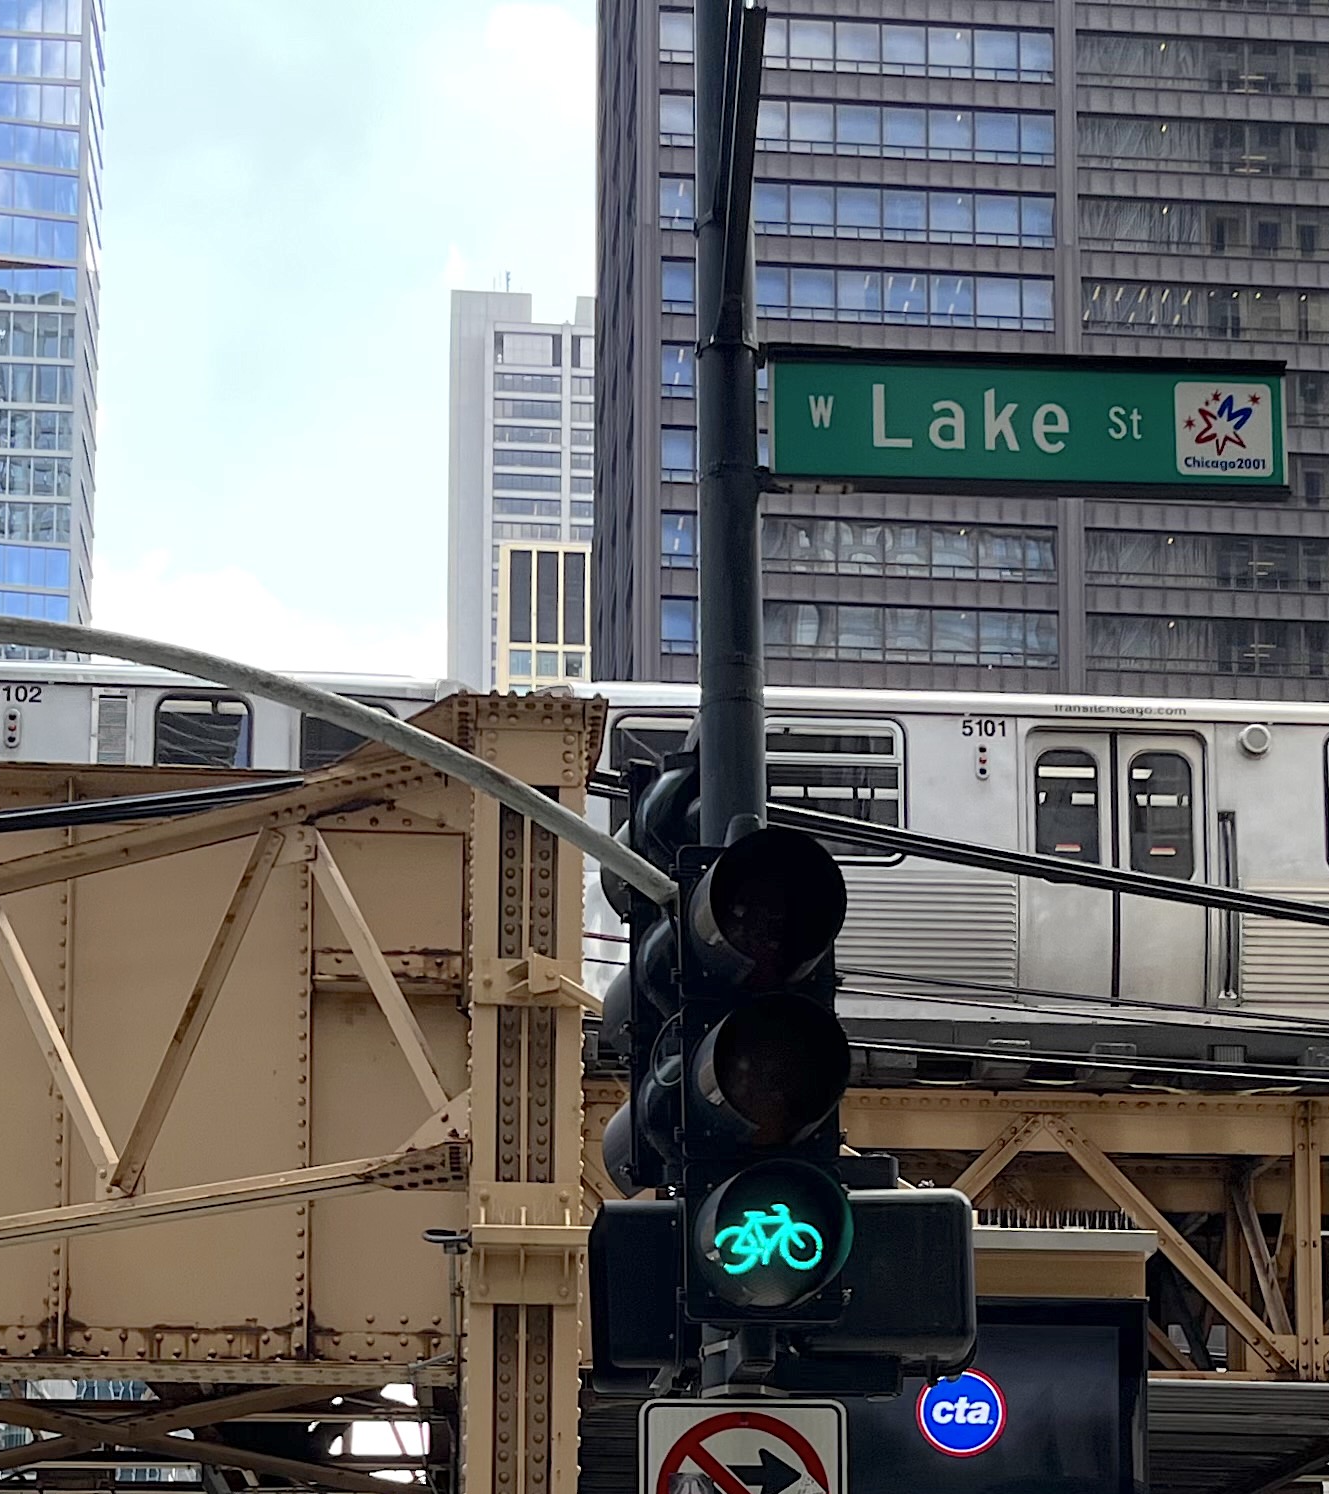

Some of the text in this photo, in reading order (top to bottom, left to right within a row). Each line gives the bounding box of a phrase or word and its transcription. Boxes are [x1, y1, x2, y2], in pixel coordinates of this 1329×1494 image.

[808, 383, 1143, 453] W Lake St
[1184, 455, 1267, 472] Chicago2001
[961, 719, 1006, 737] 5101
[932, 1397, 993, 1424] cta
